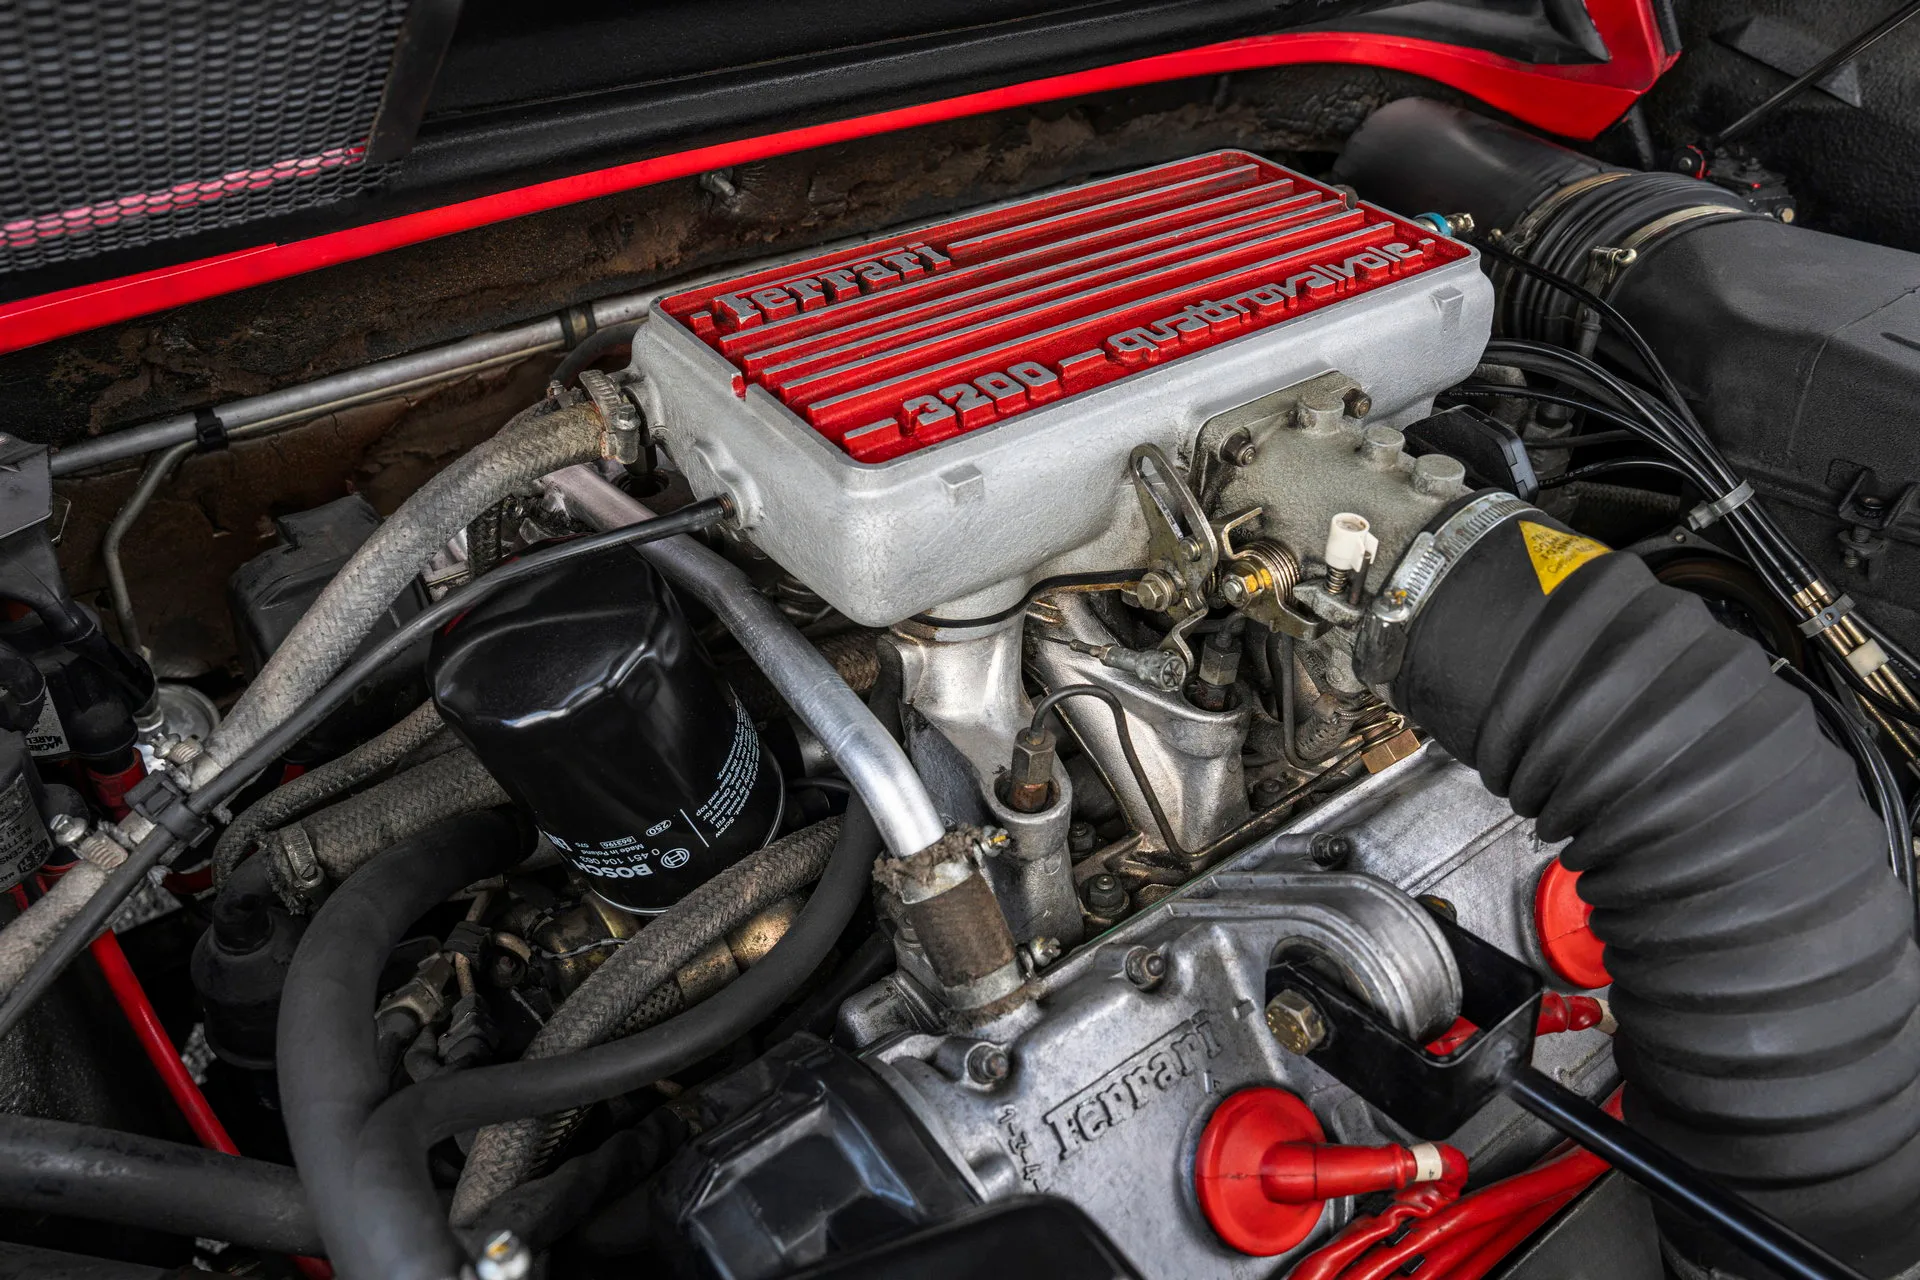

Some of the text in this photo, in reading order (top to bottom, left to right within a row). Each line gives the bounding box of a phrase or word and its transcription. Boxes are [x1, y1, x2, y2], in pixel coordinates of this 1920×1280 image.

[713, 242, 948, 328] Ferrari
[902, 242, 1423, 428] 3200 quattrovalvole
[735, 779, 742, 790] up
[739, 785, 746, 796] by
[708, 790, 720, 806] and
[712, 788, 730, 811] Check
[730, 790, 737, 799] to
[695, 804, 708, 817] top
[709, 799, 730, 825] normal
[725, 795, 741, 816] hand.
[702, 810, 713, 821] for
[715, 816, 726, 829] Fill
[647, 821, 669, 835] 250
[715, 816, 734, 838] Screw
[0, 840, 33, 865] ACCENS
[619, 843, 645, 854] Made
[651, 848, 660, 856] 0
[602, 857, 624, 865] 104
[627, 853, 649, 863] 451
[571, 858, 653, 878] BOSCH
[1042, 1009, 1221, 1160] Ferrari
